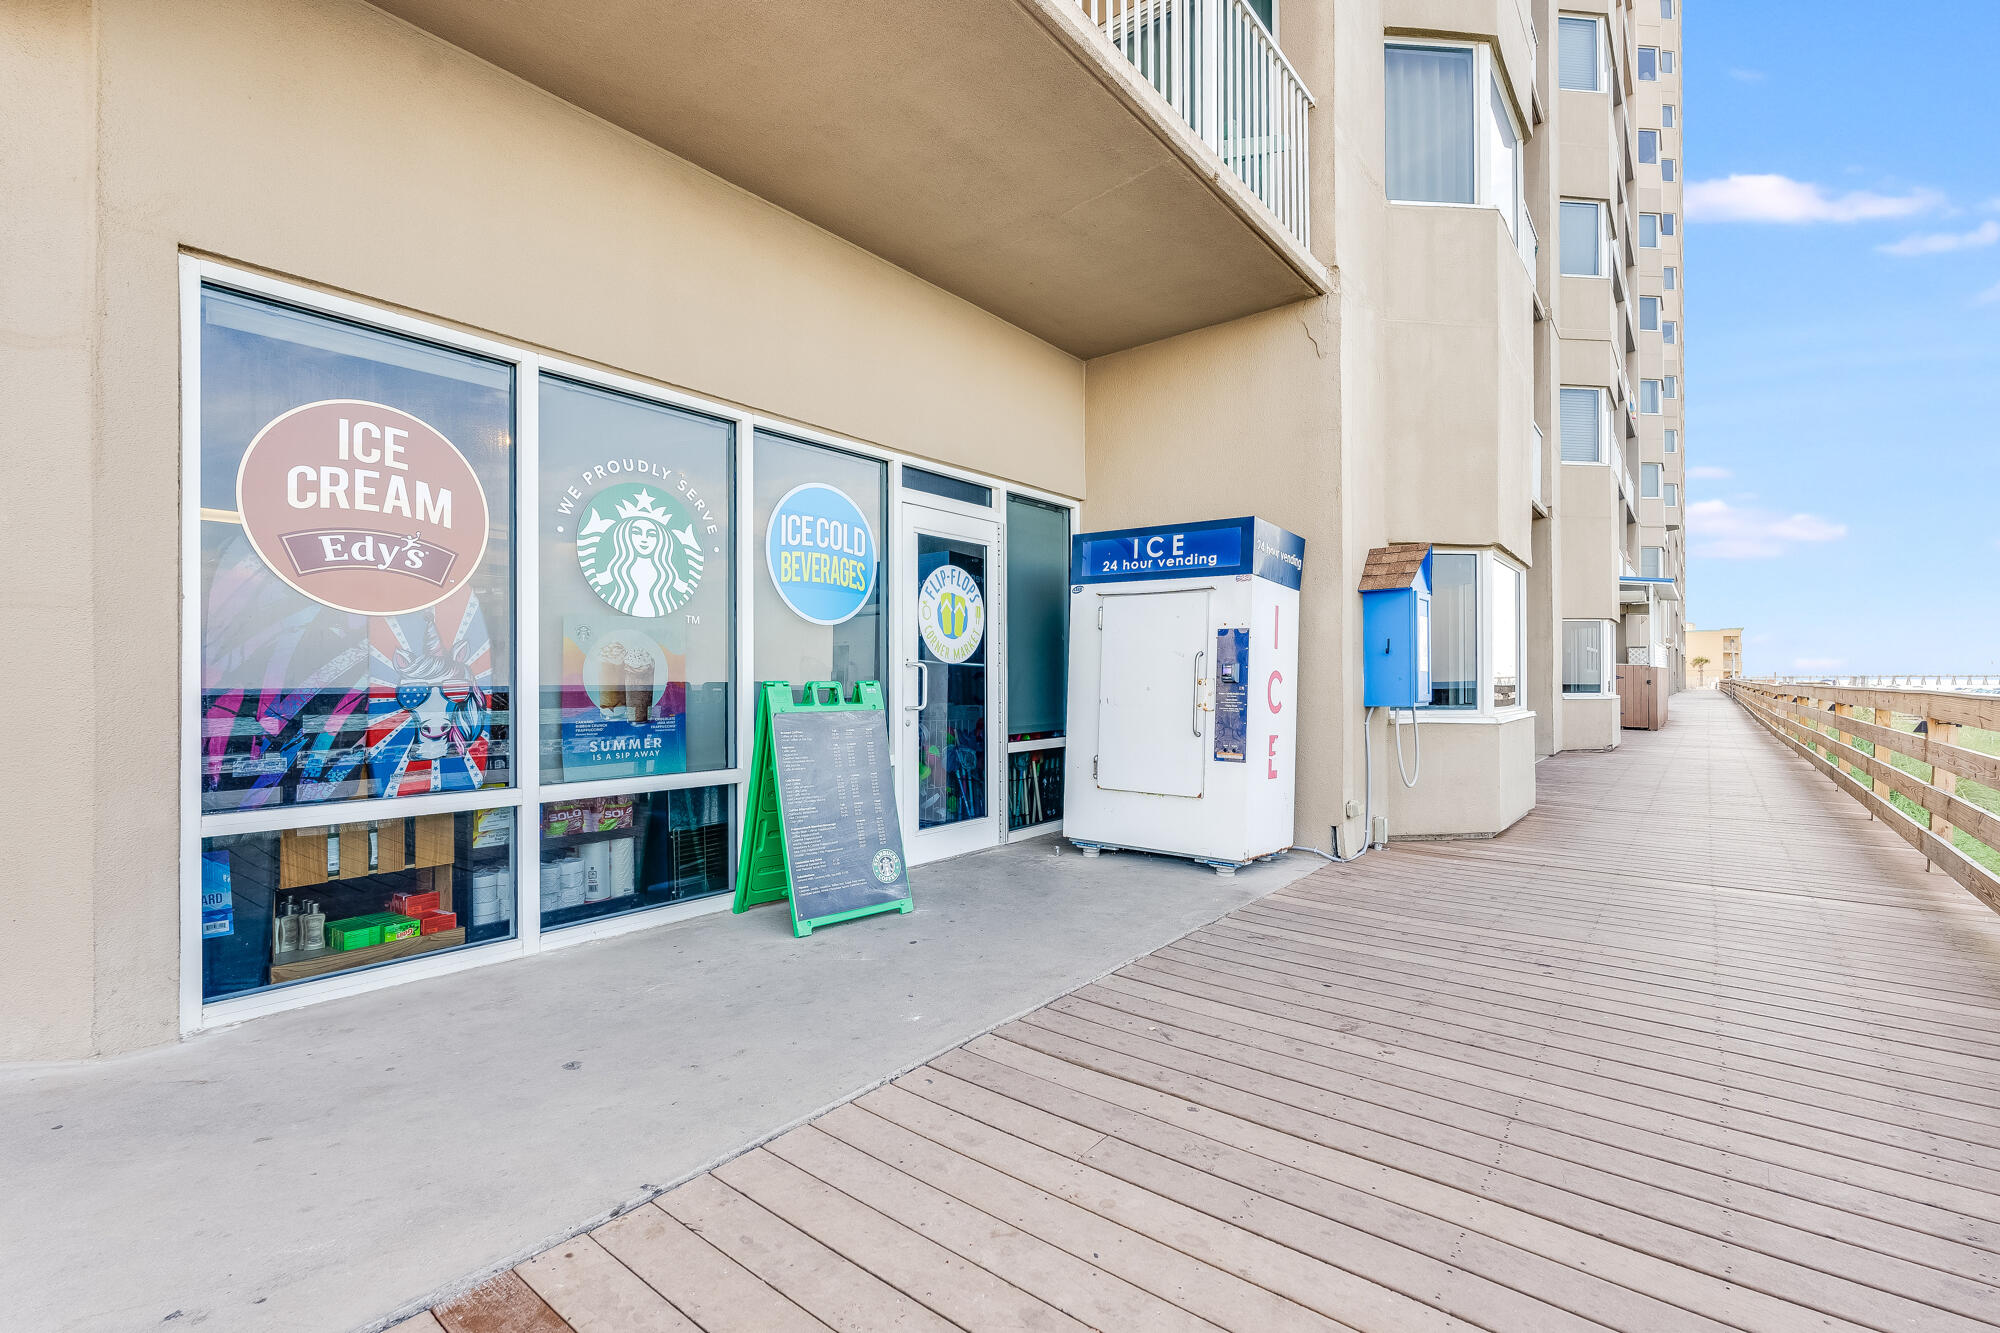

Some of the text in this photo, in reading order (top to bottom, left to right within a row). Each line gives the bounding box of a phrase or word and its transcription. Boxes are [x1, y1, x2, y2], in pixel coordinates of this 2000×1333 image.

[339, 418, 409, 471] ICE
[287, 465, 452, 529] CREAM
[557, 458, 718, 535] WE PROUDLY SERVE
[781, 513, 866, 557] ICE COLD
[1133, 534, 1185, 559] ICE
[318, 534, 427, 571] Edy's
[1102, 553, 1217, 572] 24 hour vending
[1280, 551, 1302, 571] vending
[780, 551, 866, 592] BEVERAGES
[924, 568, 980, 603] FLIP-FLOPS
[924, 625, 981, 661] CORNER MARKET
[1267, 605, 1283, 780] ICE
[589, 737, 663, 753] SUMMER
[592, 753, 602, 761] IS
[634, 750, 661, 758] AWAY
[548, 808, 583, 823] SOLO
[873, 850, 899, 866] STARBUCKS
[878, 873, 898, 881] COFFEE
[202, 893, 223, 905] ARD
